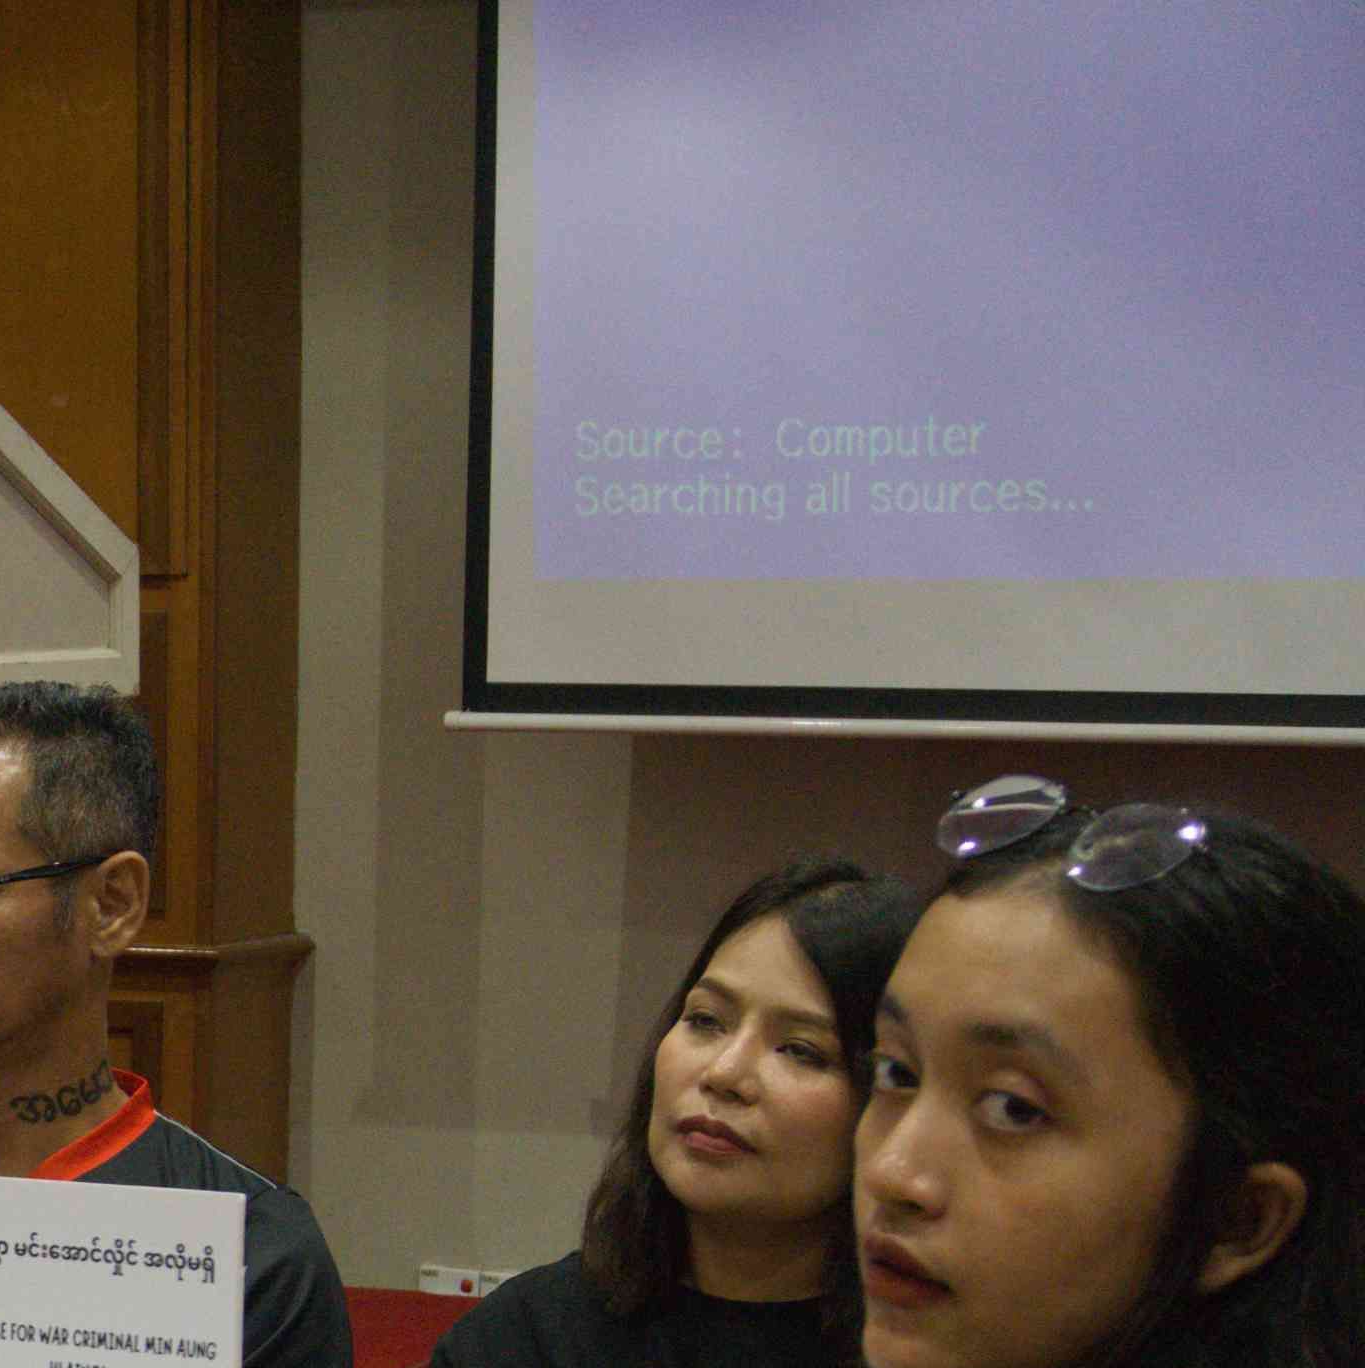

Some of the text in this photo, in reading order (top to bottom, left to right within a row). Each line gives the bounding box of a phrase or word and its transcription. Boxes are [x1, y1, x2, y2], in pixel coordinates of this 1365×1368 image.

[574, 415, 988, 466] Source: Computer
[574, 472, 1094, 521] Searching all sources...
[10, 1322, 36, 1342] FOR
[39, 1326, 69, 1346] WAR
[72, 1329, 140, 1353] CRIMINAL
[144, 1336, 173, 1355] MIN
[176, 1338, 217, 1361] AUNG
